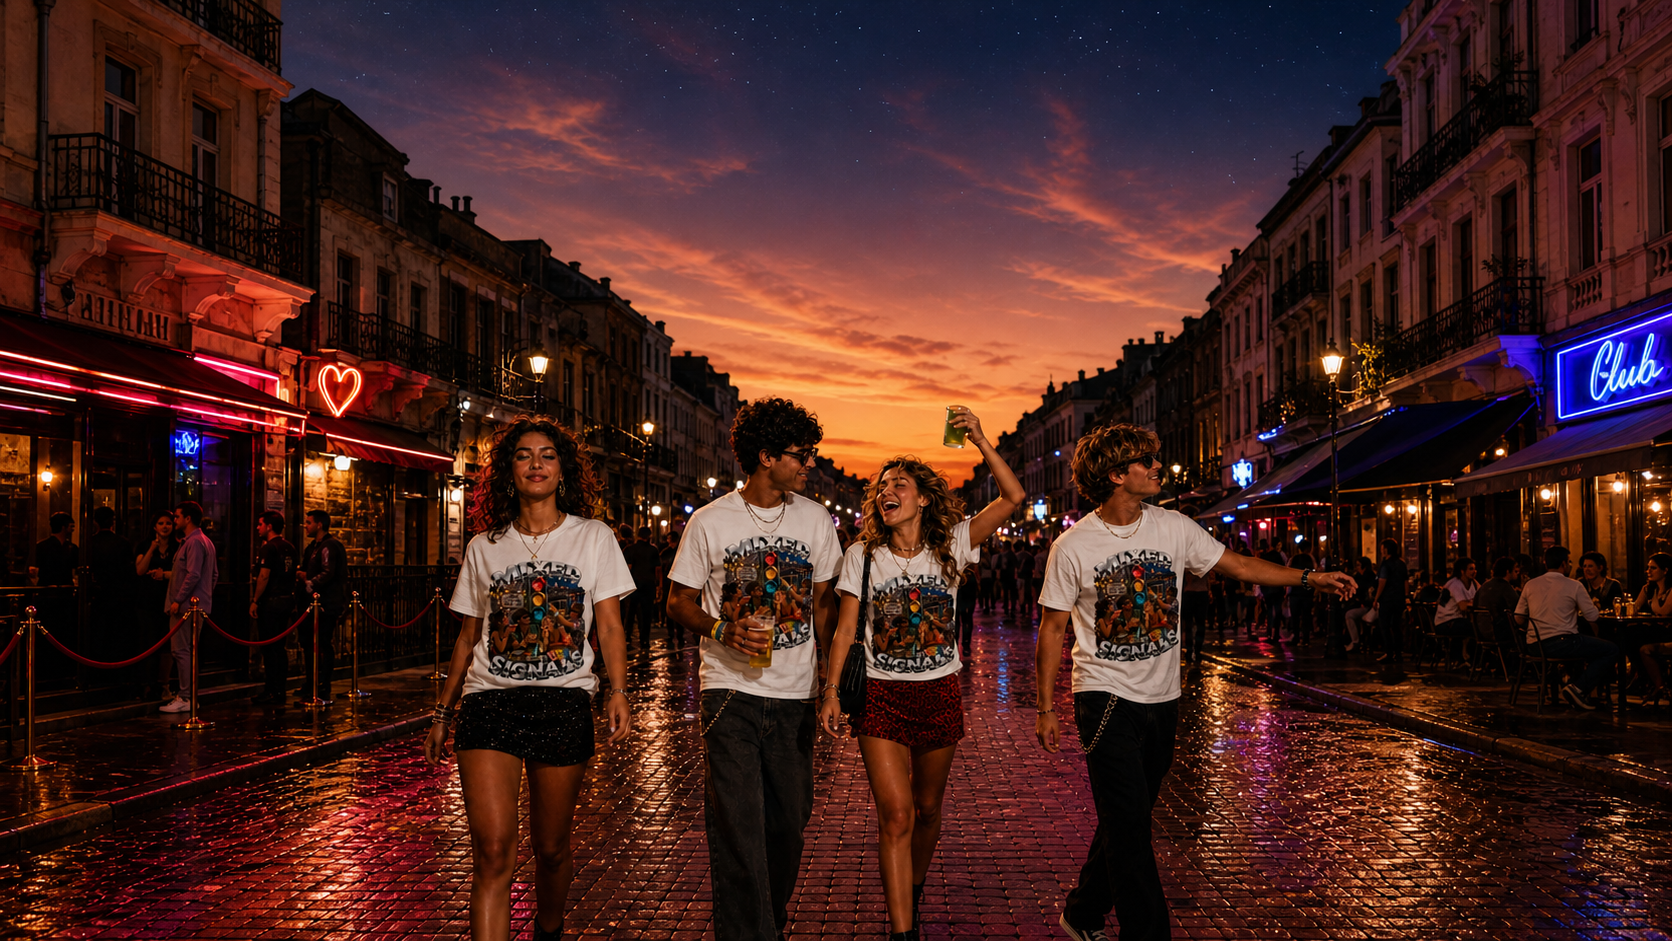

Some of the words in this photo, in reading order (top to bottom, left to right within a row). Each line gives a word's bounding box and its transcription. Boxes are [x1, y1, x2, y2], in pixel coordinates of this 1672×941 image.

[1590, 333, 1664, 401] Club
[725, 535, 811, 559] MIXED
[491, 560, 582, 586] MIXED
